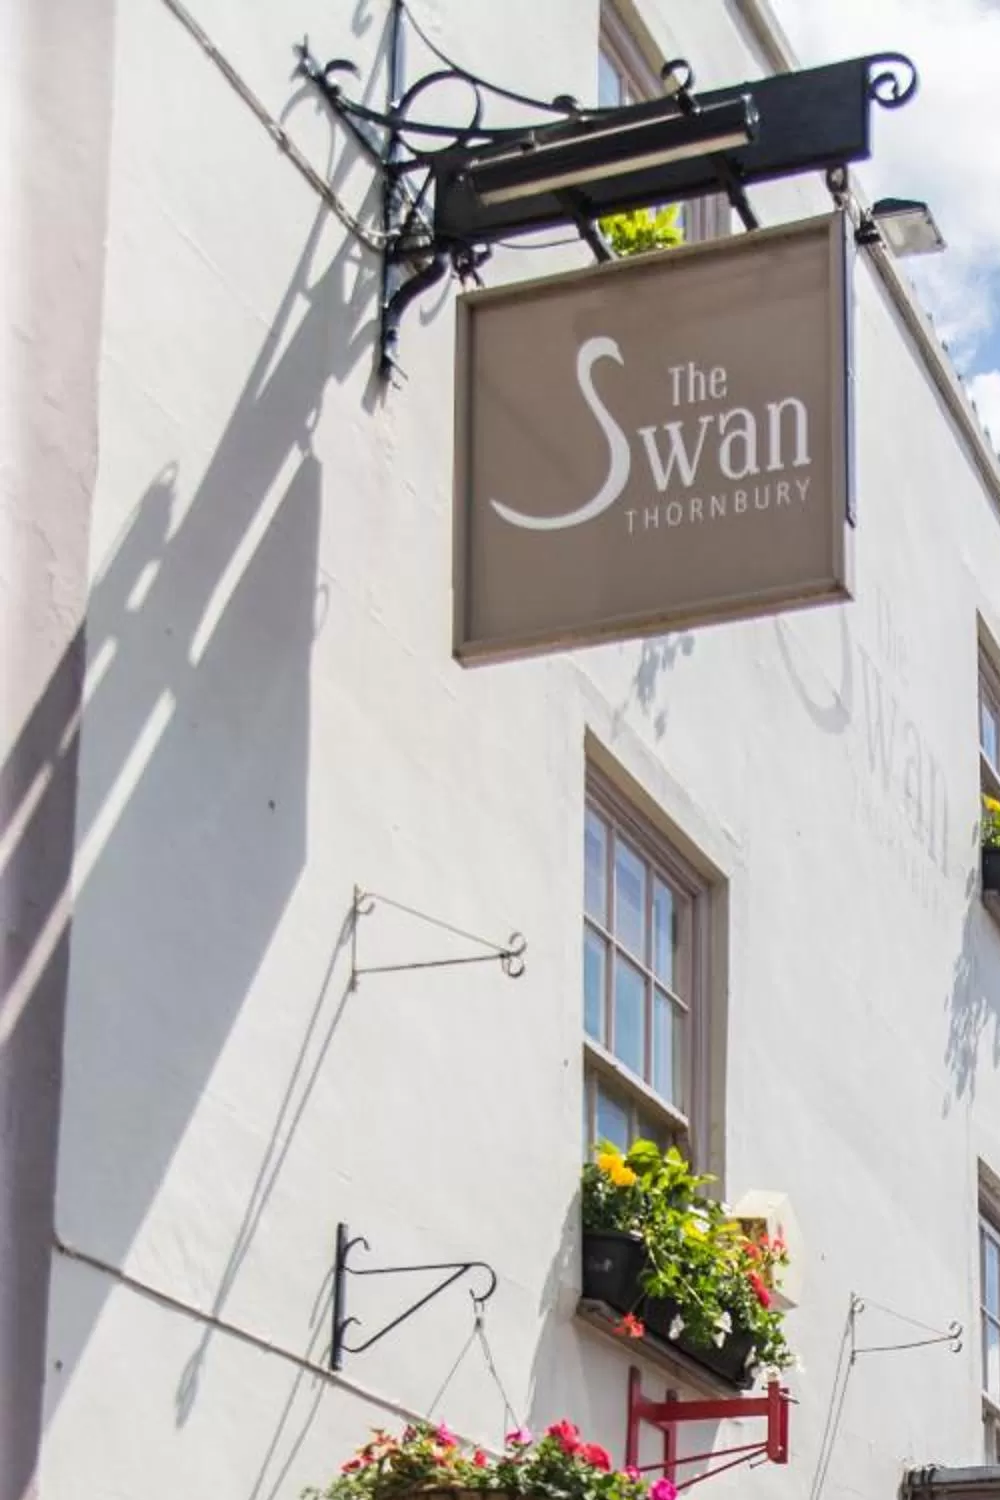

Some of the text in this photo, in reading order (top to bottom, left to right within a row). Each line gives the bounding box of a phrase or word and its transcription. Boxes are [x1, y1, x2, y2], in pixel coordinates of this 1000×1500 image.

[667, 362, 728, 406] The
[489, 335, 813, 531] Swan
[625, 478, 813, 534] THORNBURY
